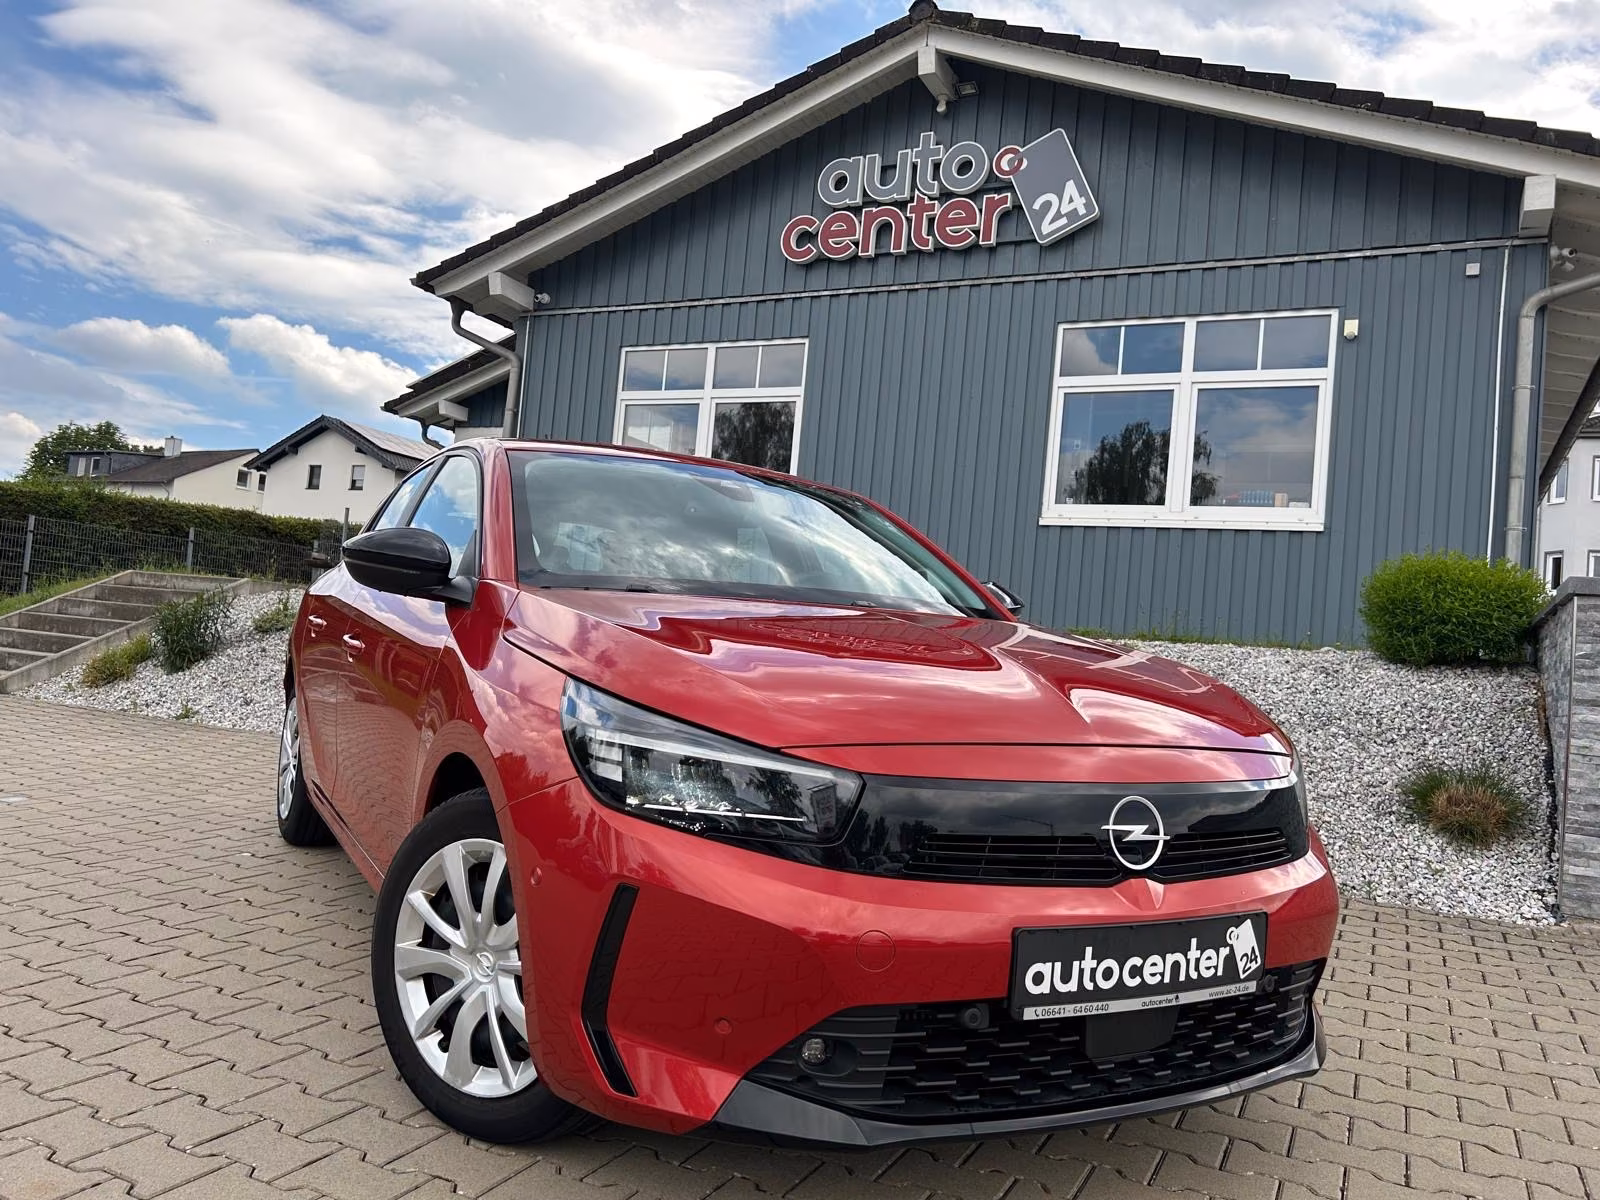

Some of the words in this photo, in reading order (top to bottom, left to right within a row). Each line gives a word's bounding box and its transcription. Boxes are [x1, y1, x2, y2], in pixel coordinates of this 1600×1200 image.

[817, 131, 989, 208] auto
[780, 189, 1012, 265] center
[1032, 179, 1087, 236] 24
[1024, 937, 1230, 995] autocenter
[1240, 945, 1258, 975] 24
[1208, 984, 1250, 998] www.ac-24.de
[1041, 1007, 1066, 1017] 06641
[1141, 996, 1174, 1008] autocenter
